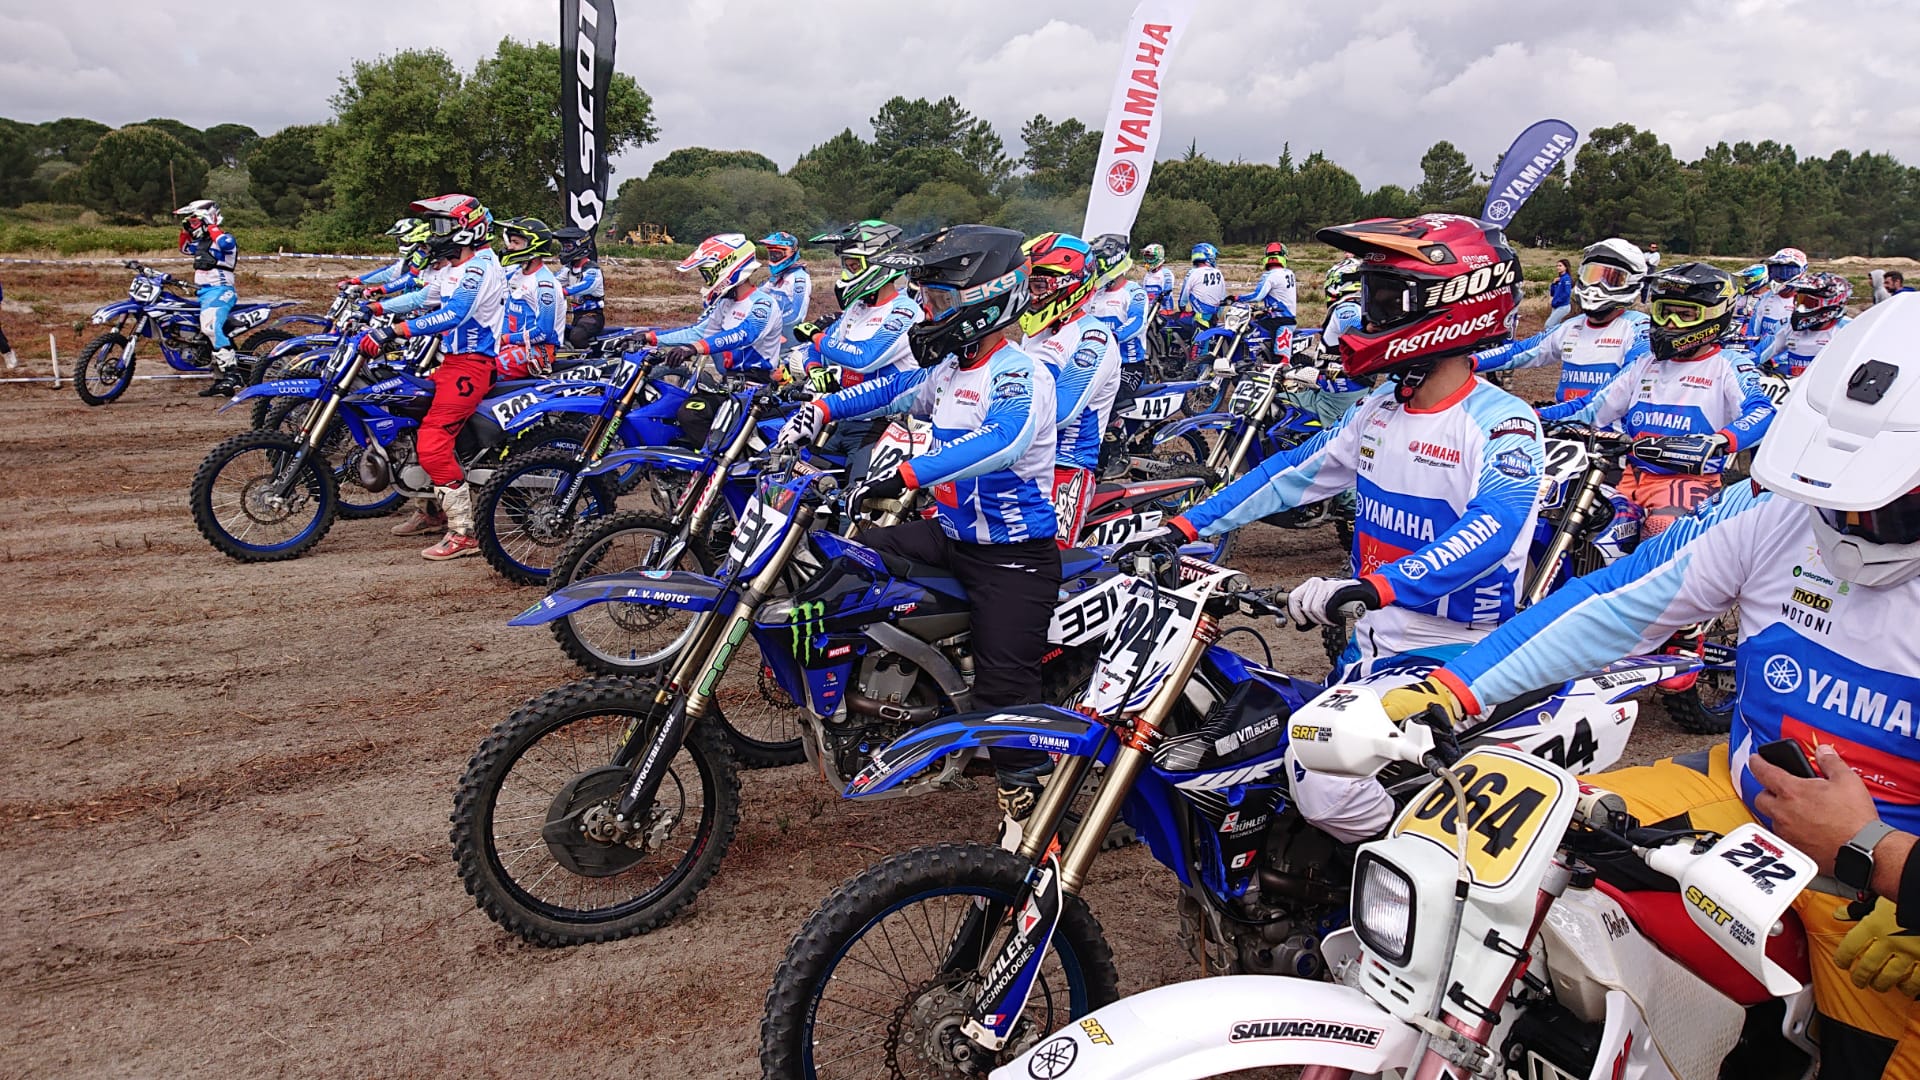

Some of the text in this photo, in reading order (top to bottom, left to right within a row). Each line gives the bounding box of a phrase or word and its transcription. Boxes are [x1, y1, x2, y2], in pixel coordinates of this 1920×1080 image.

[1113, 23, 1173, 154] YAMAHA
[1500, 133, 1572, 201] YAMAHA
[881, 254, 919, 266] Airoh
[960, 270, 1018, 304] EKS
[1202, 271, 1222, 287] 429
[1424, 259, 1516, 308] 100%
[239, 310, 262, 330] 312
[1385, 309, 1499, 361] FASTHOUSE
[1567, 370, 1611, 385] YAMAHA
[1142, 397, 1171, 419] 447
[1420, 441, 1462, 464] YAMAHA
[1364, 496, 1436, 543] YAMAHA
[1425, 513, 1503, 572] YAMAHA
[1801, 569, 1835, 587] valorpneu
[627, 588, 691, 605] H. V. MOTOS
[1793, 588, 1831, 612] moto
[1780, 602, 1834, 636] MOTONI
[829, 645, 851, 657] MOTUL
[1041, 647, 1064, 664] OTUL
[1038, 735, 1070, 749] YAMAHA
[1291, 724, 1319, 741] SRT
[1414, 763, 1547, 859] 664
[1230, 849, 1257, 869] G7
[1719, 841, 1797, 889] 212
[1685, 884, 1733, 928] SRT
[1728, 930, 1748, 947] TEAM
[1730, 924, 1757, 947] RACING
[1733, 919, 1756, 939] SALVA
[976, 943, 1036, 1015] TECHNOLOGIES
[983, 1013, 1008, 1026] G7
[1079, 1016, 1115, 1047] SRT
[1230, 1022, 1382, 1048] SALVAGARAGE
